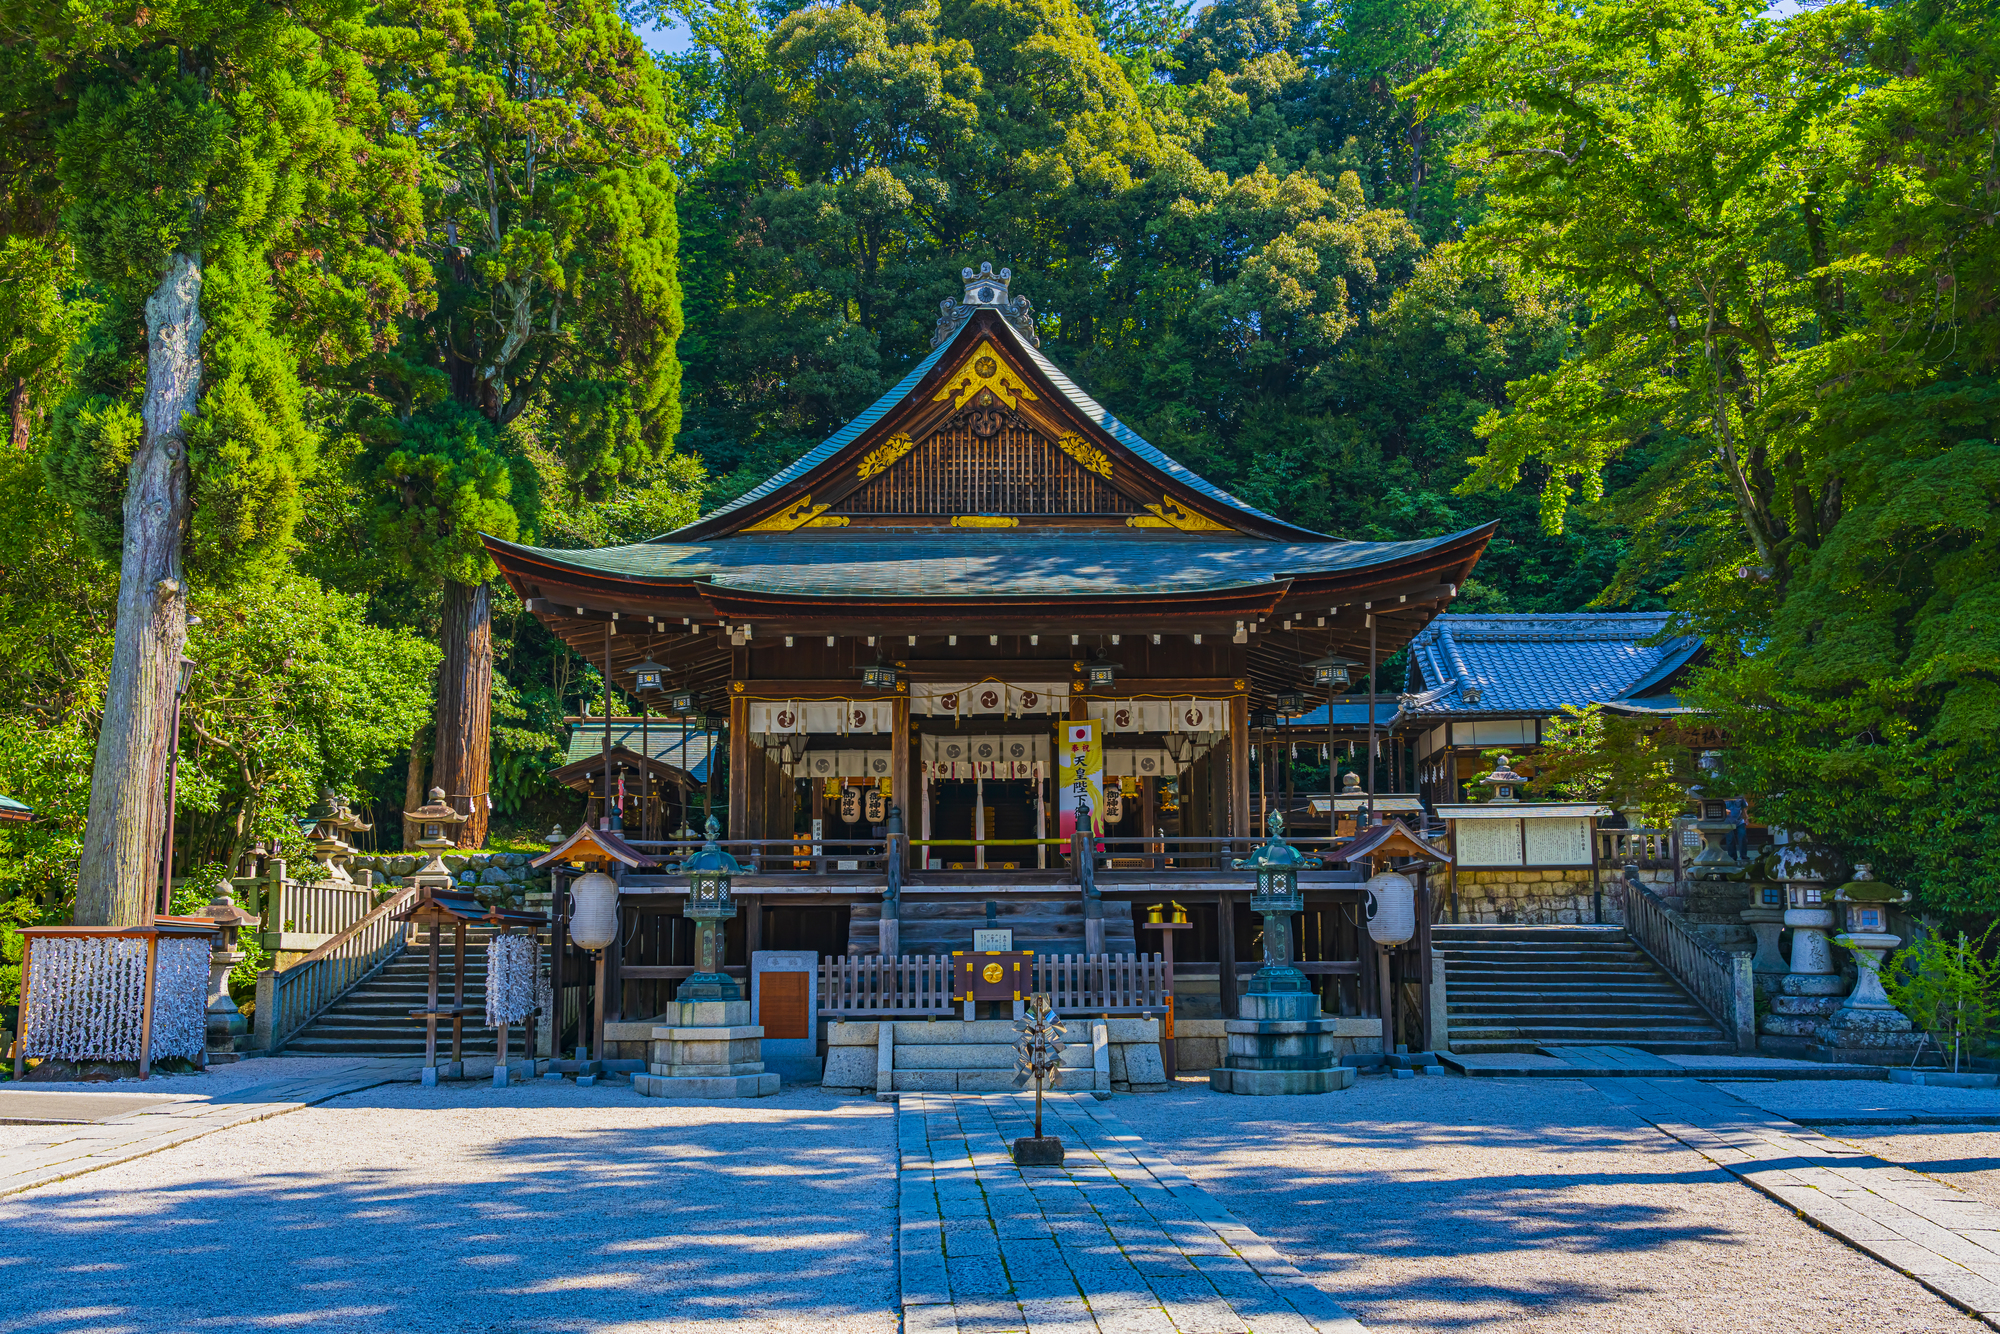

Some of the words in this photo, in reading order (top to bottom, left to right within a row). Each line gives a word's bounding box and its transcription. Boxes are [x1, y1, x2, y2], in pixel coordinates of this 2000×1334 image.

[1071, 743, 1090, 753] 奉祝
[1073, 755, 1088, 830] 天皇陛下
